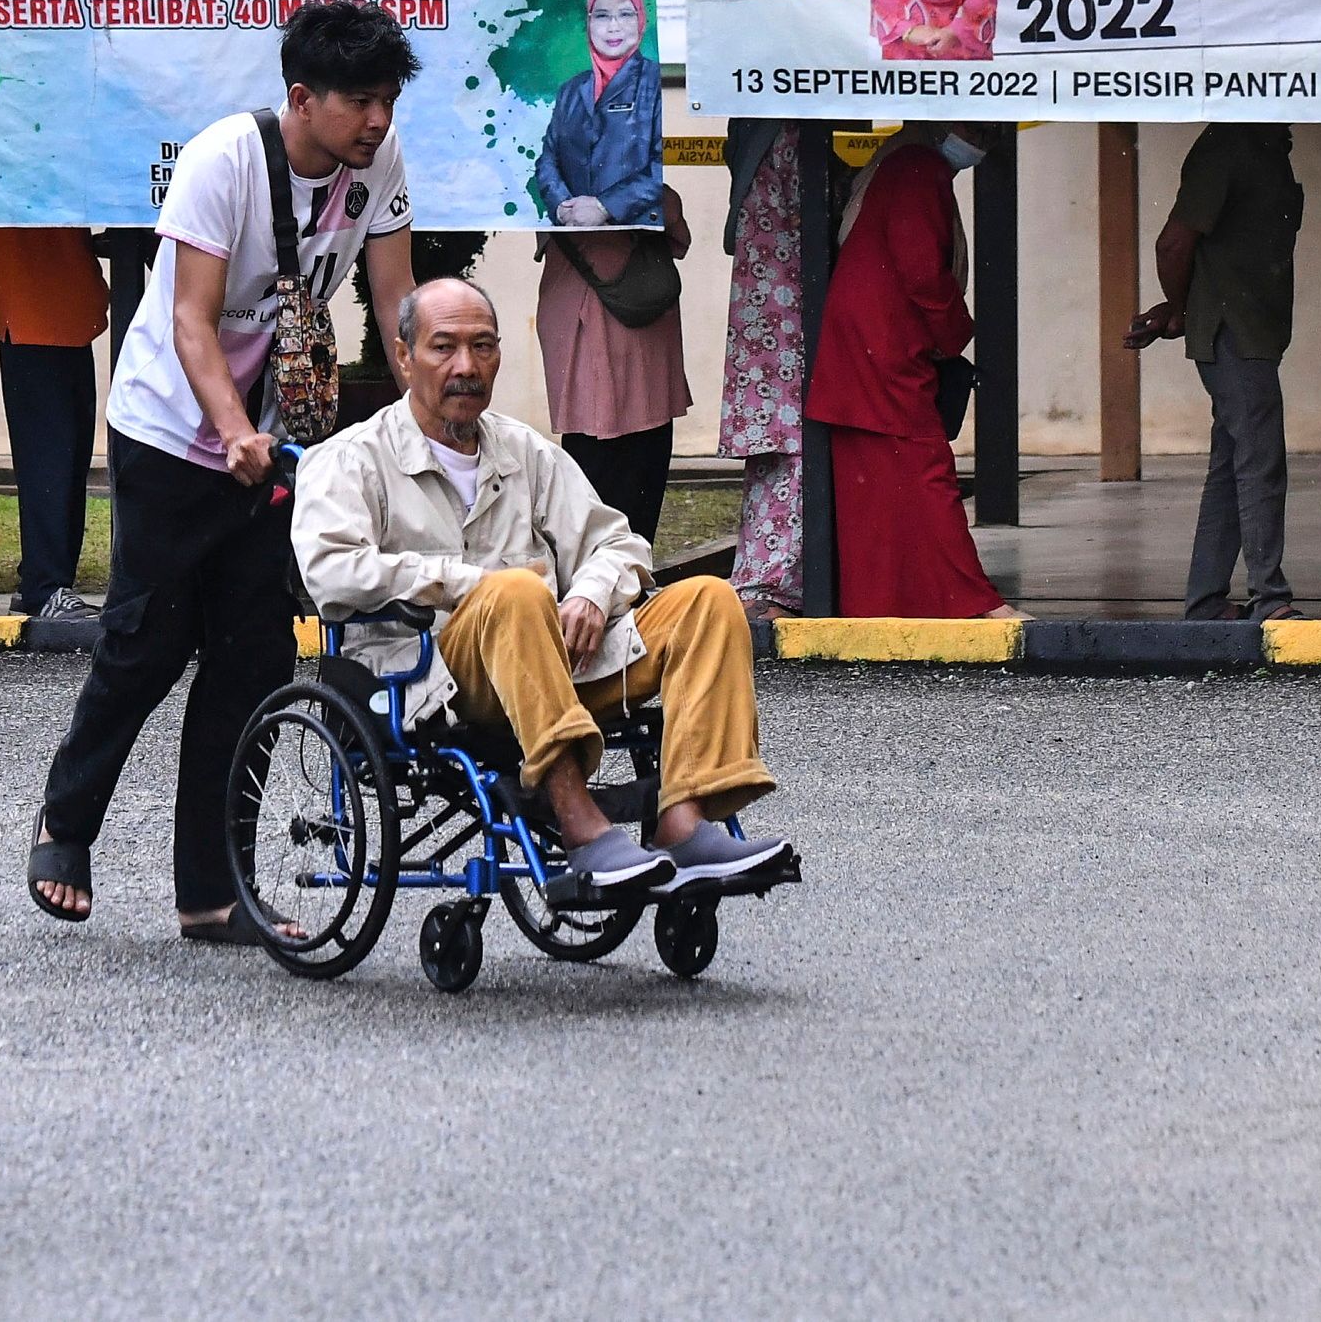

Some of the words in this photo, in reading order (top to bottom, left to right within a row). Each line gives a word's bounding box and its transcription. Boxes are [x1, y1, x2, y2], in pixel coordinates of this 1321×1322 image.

[731, 69, 765, 96] 13
[773, 69, 960, 97] SEPTEMBER
[970, 71, 1038, 97] 2022
[1072, 72, 1196, 98] PESISIR
[1205, 72, 1318, 98] PANTAI
